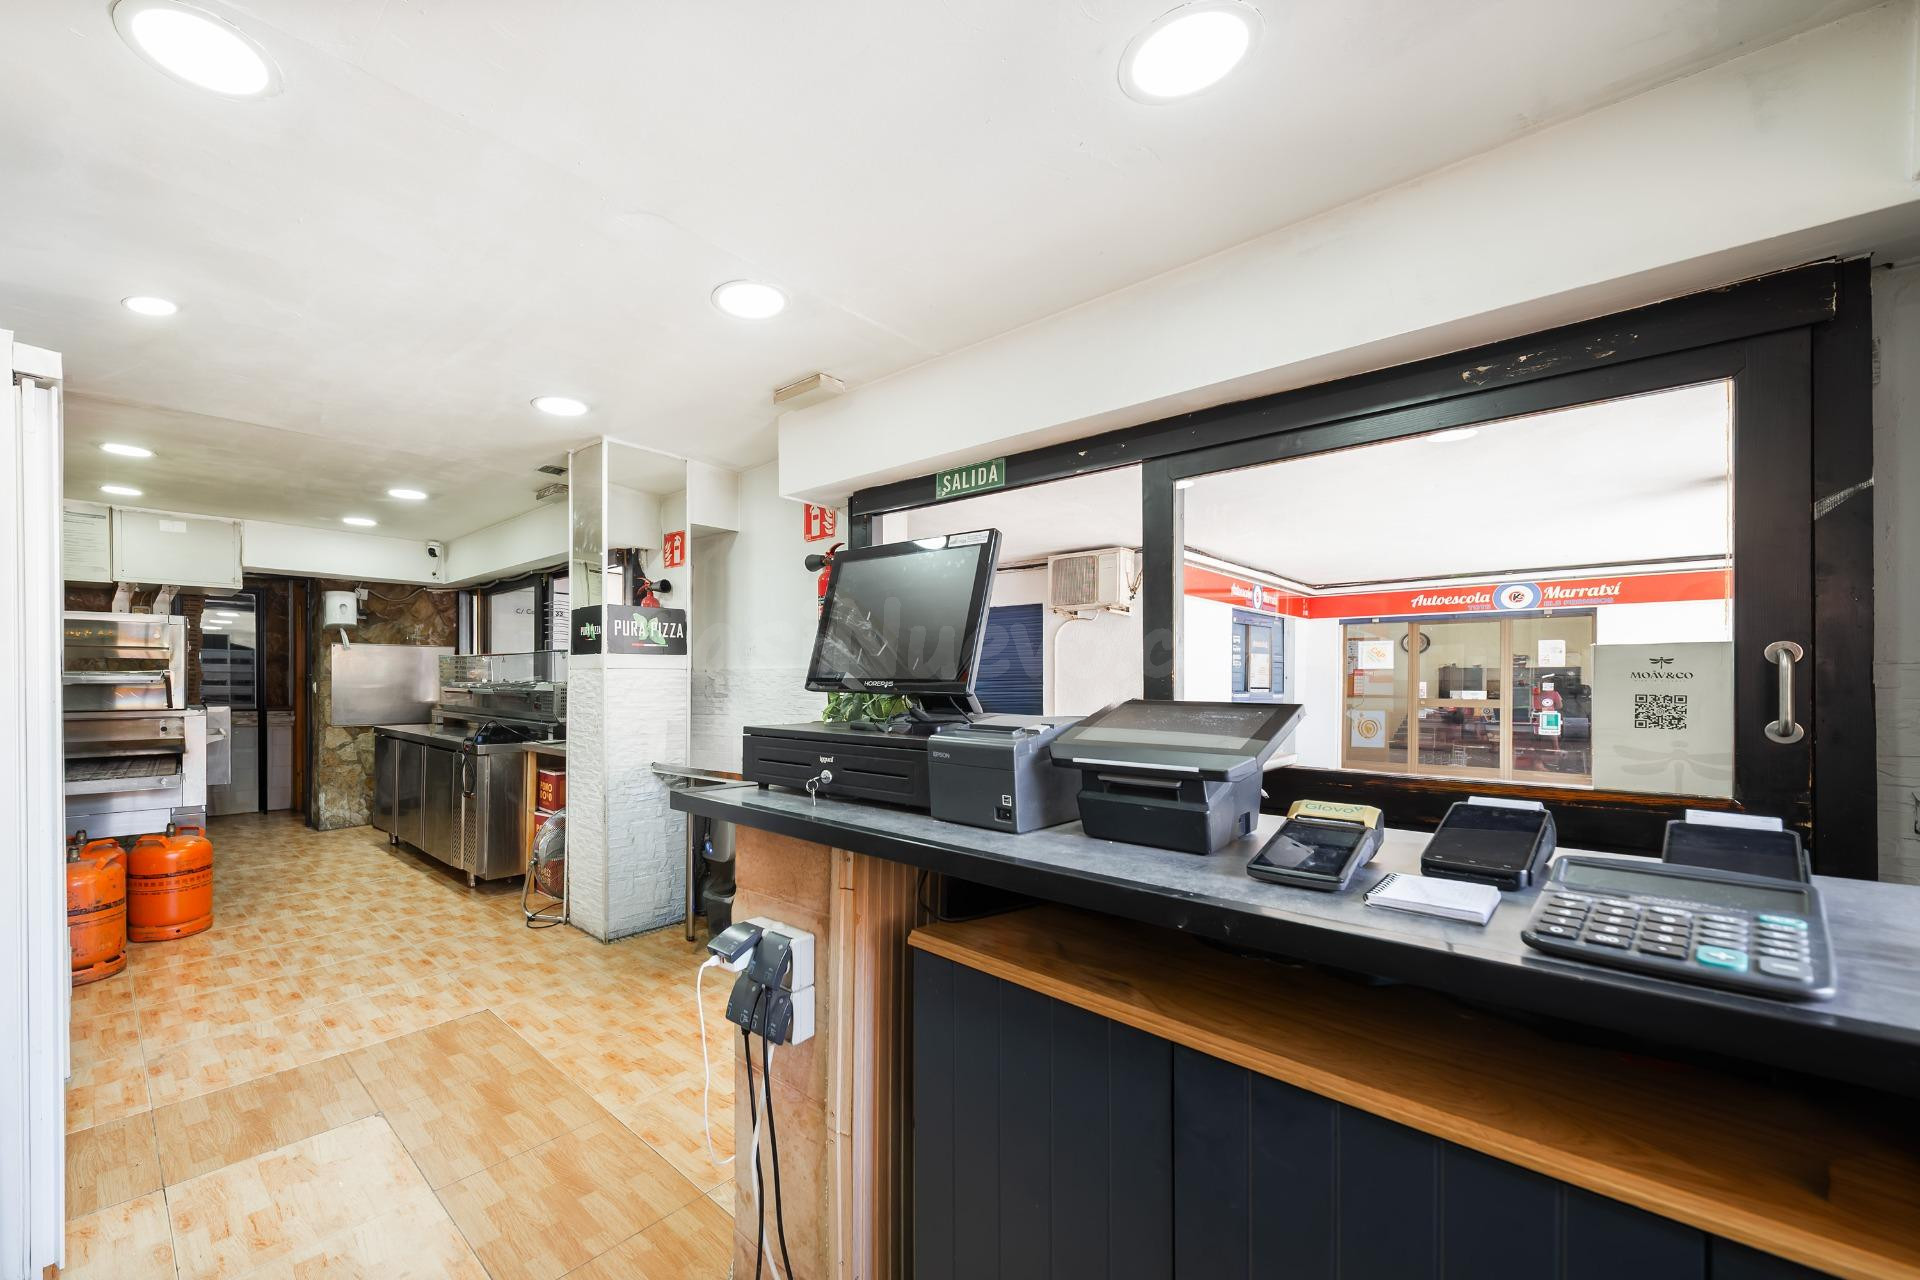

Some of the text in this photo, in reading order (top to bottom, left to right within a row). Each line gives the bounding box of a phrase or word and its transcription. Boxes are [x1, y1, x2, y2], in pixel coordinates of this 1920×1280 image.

[943, 464, 998, 493] SALIDA
[1410, 581, 1622, 608] Autoescola Marratxí
[614, 619, 684, 639] PURA PIZZA
[933, 751, 950, 759] EPSON
